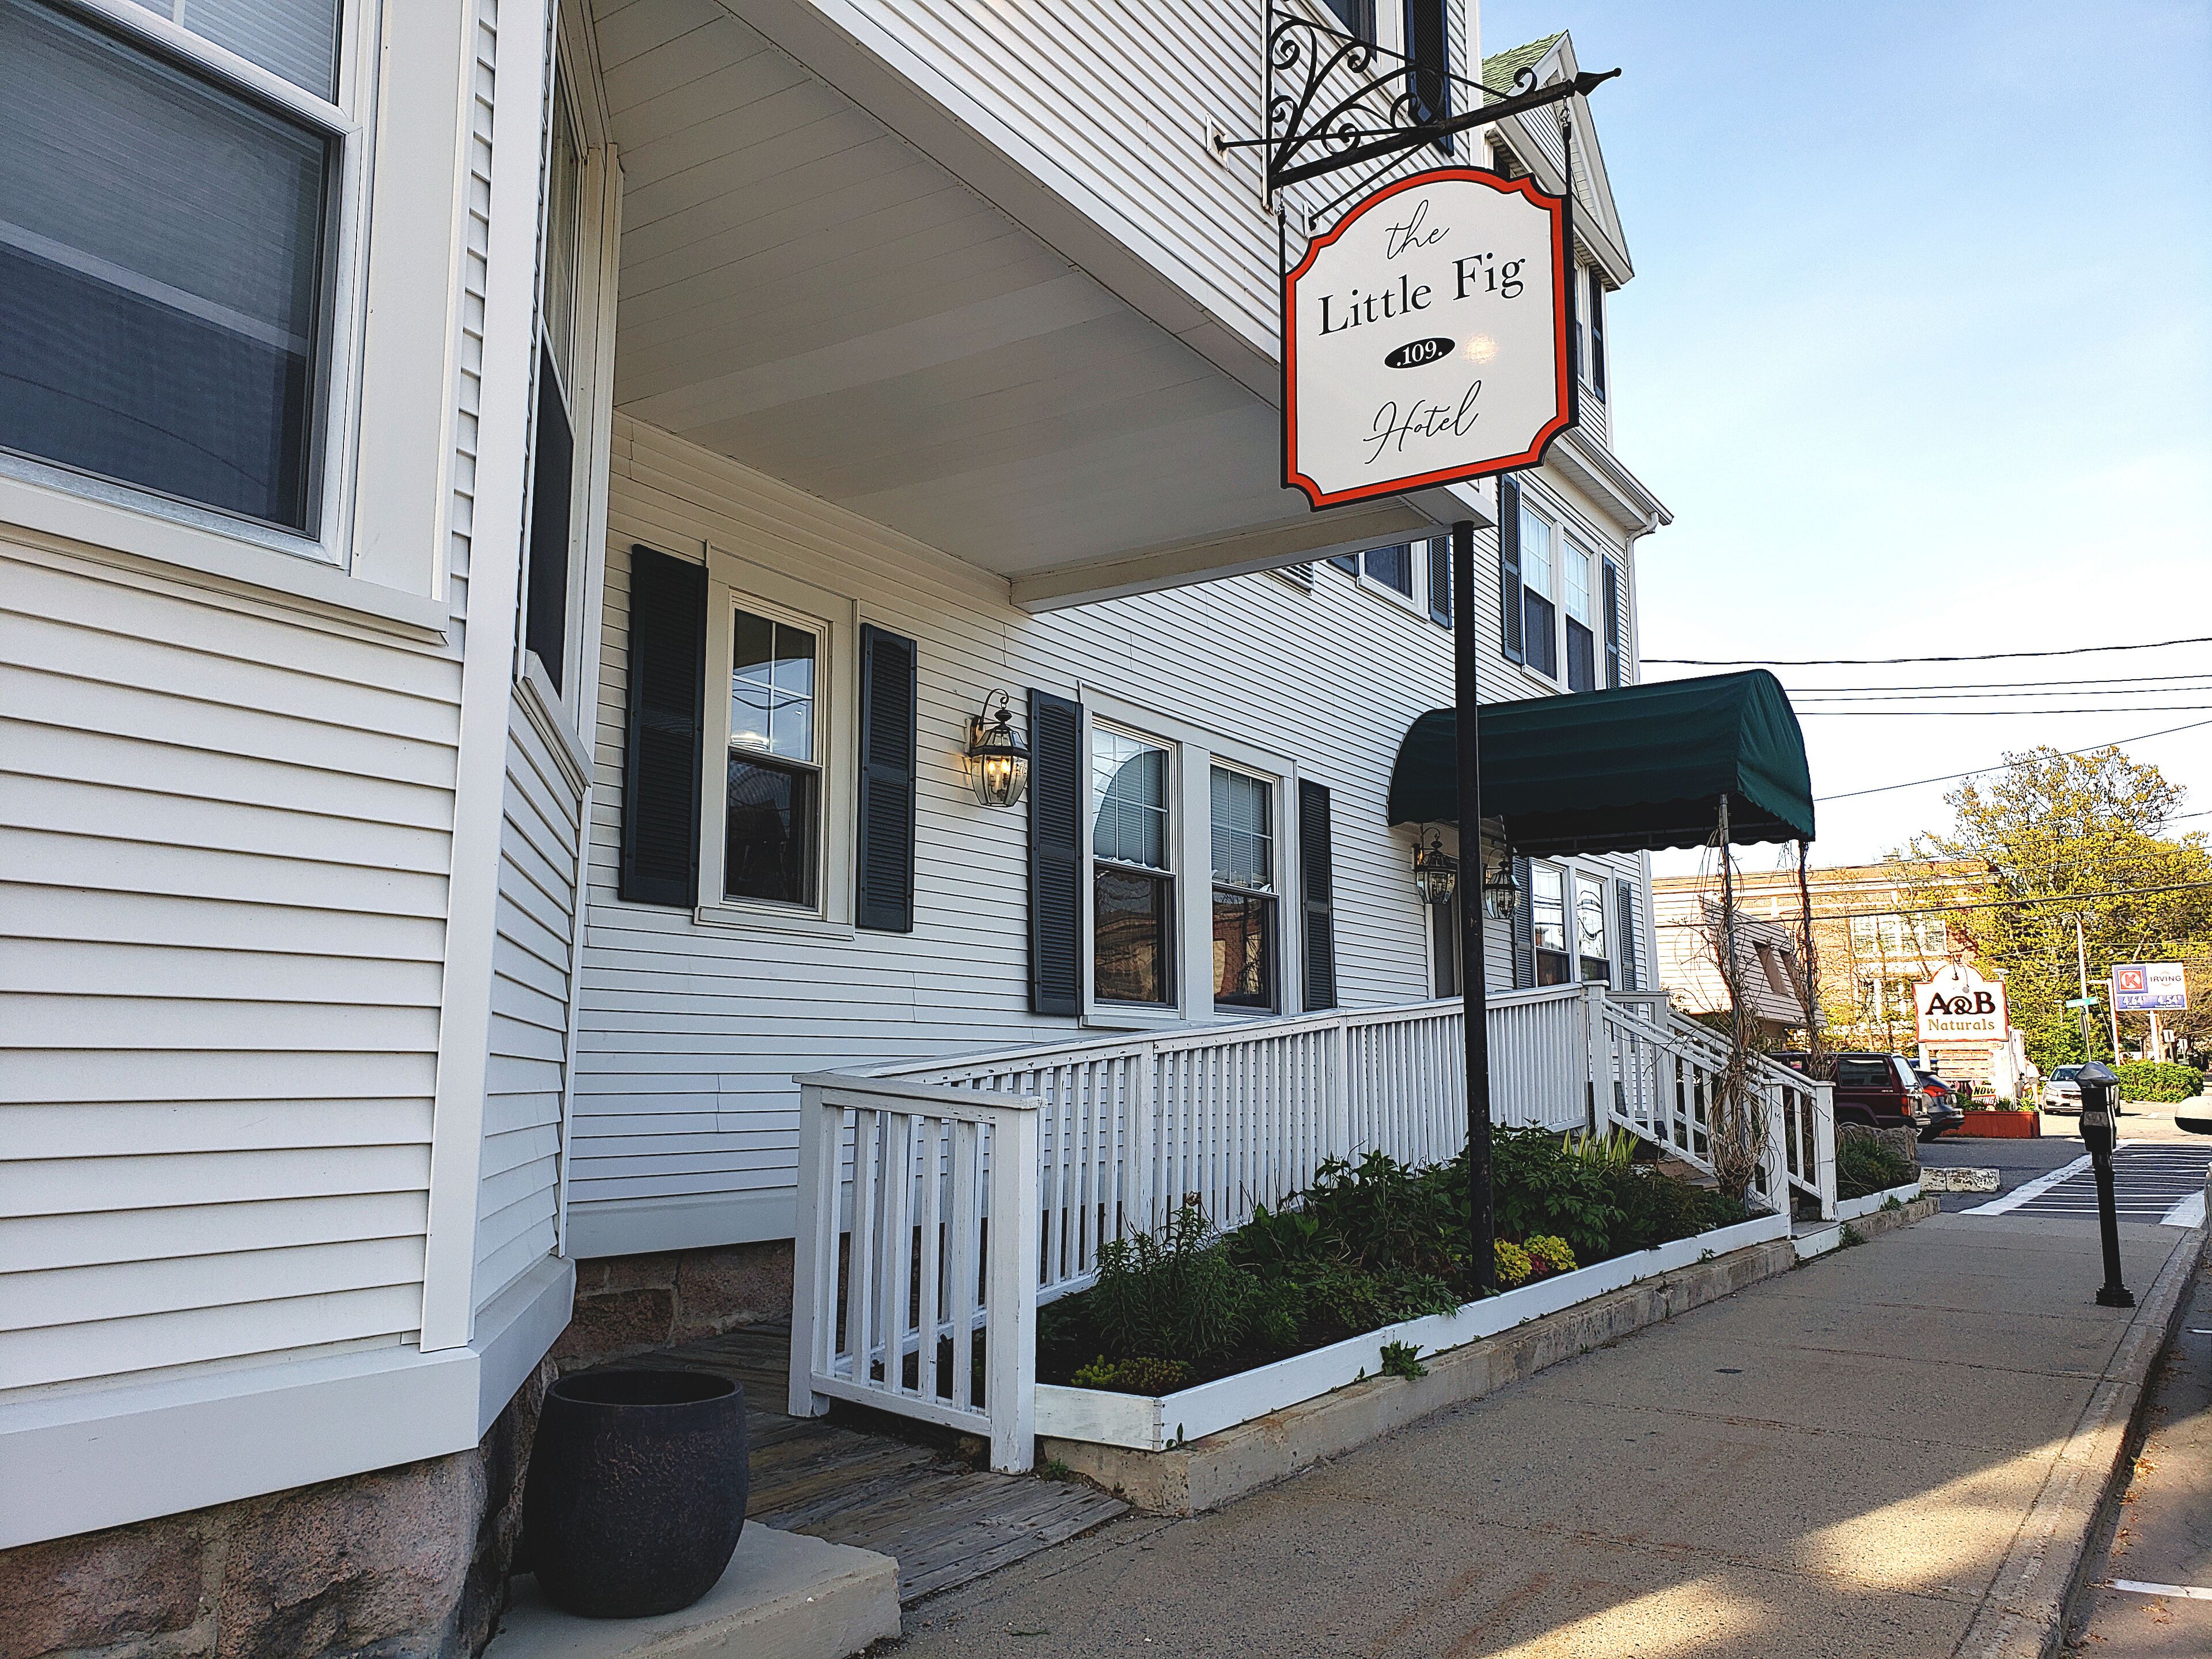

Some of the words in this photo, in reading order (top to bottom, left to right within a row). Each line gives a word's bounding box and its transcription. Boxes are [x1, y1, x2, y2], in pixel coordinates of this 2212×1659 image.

[1385, 199, 1450, 259] the
[1318, 274, 1431, 336] Little
[1452, 252, 1526, 301] Fig
[1363, 380, 1482, 464] Hotel
[1925, 991, 1995, 1015] A&B
[1928, 1019, 1995, 1031] Naturals
[1974, 1086, 1995, 1094] NOW
